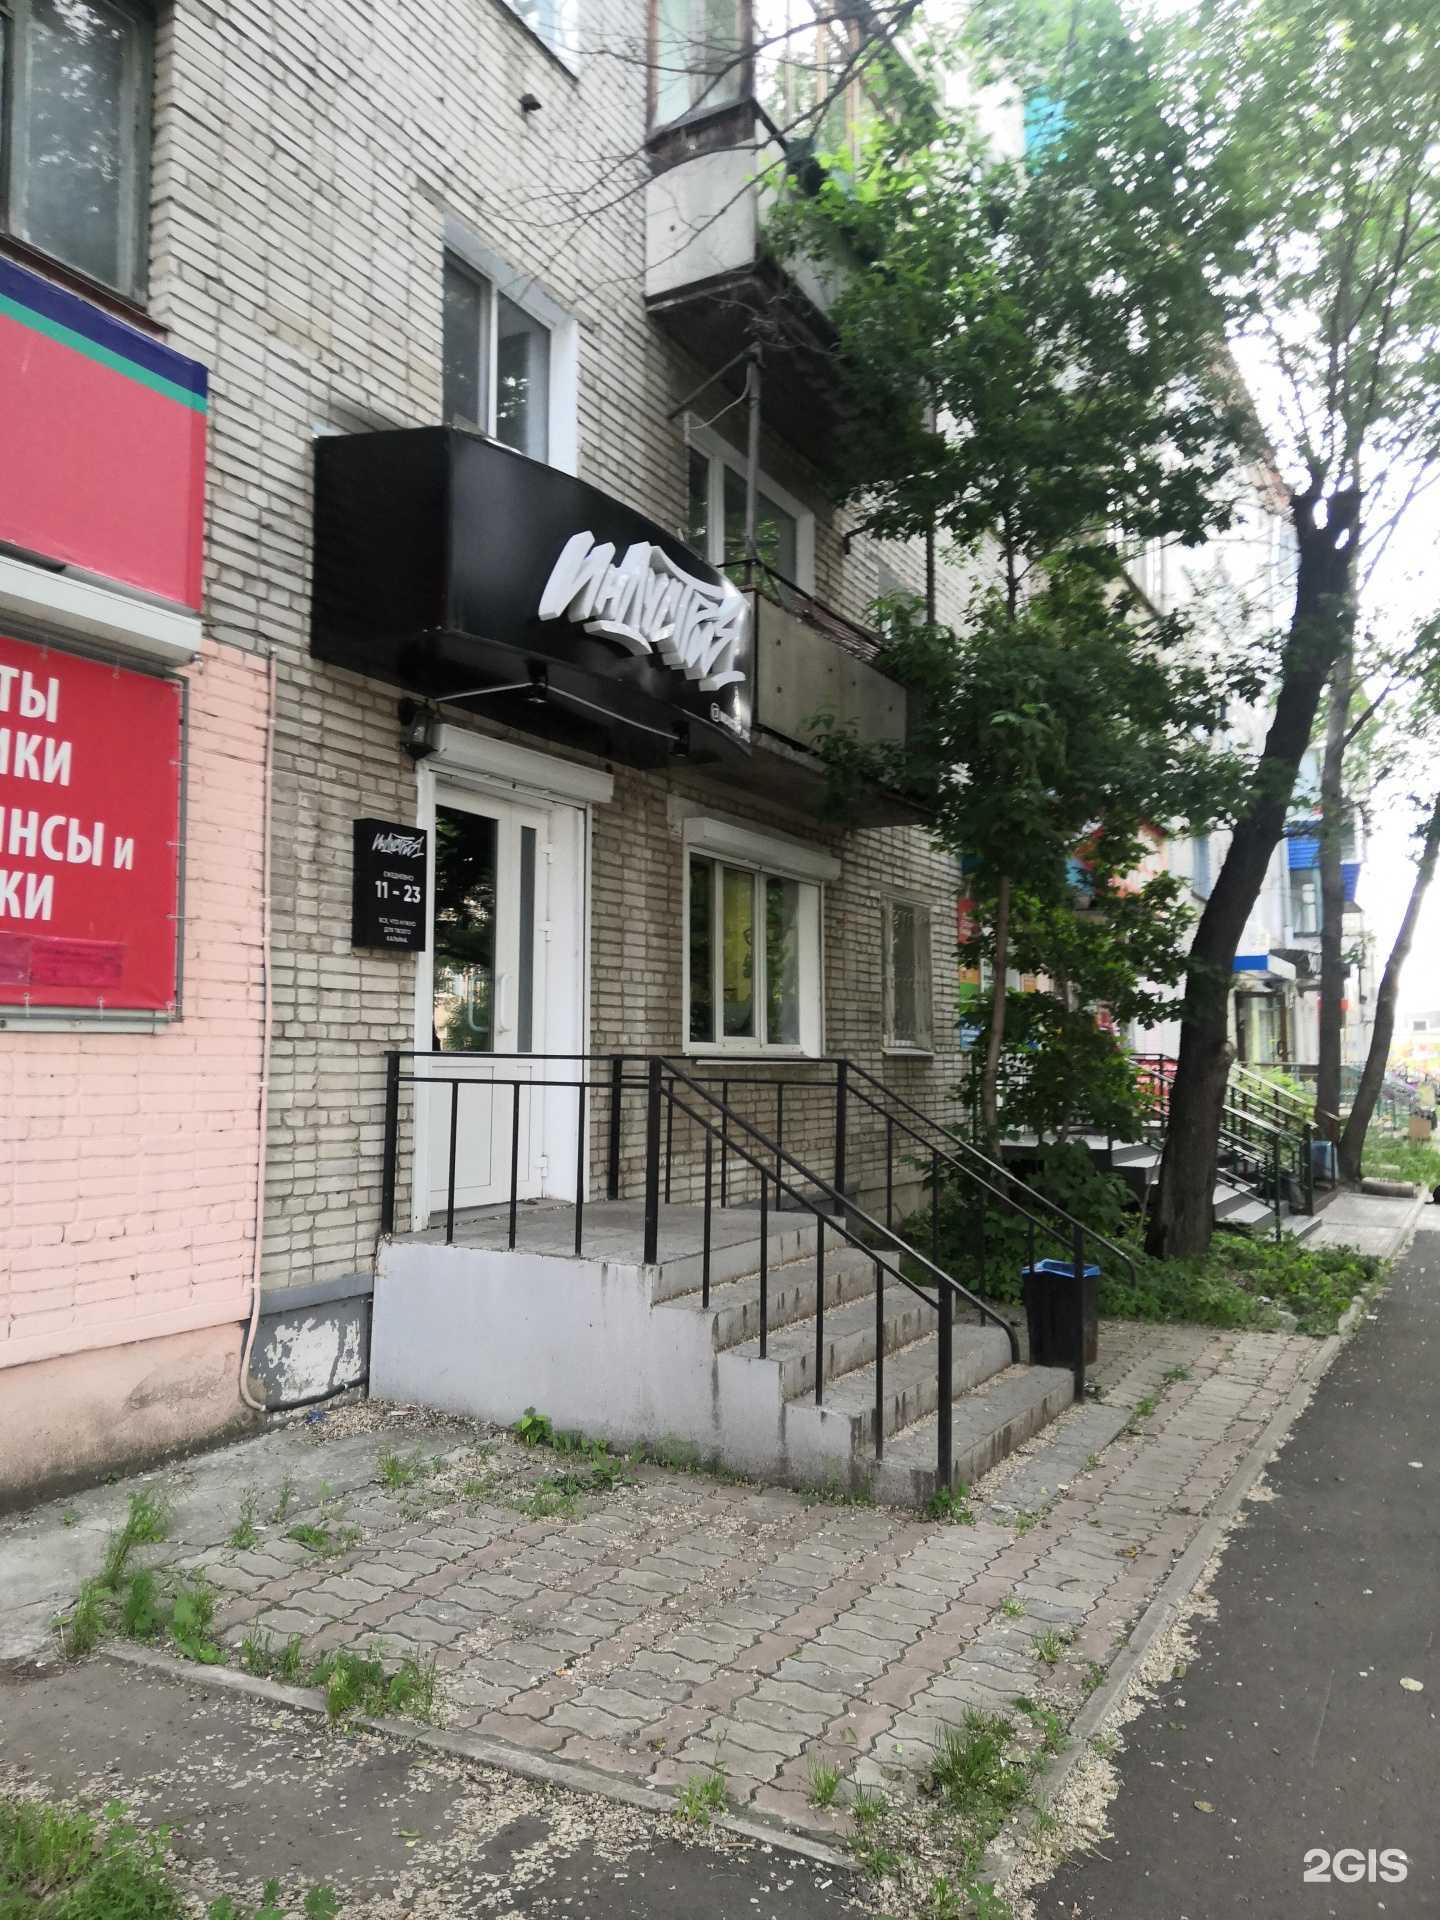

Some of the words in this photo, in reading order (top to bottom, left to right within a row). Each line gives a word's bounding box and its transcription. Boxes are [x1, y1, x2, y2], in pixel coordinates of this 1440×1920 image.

[0, 806, 105, 867] НСЫ
[375, 880, 389, 899] 11
[403, 884, 421, 903] 23
